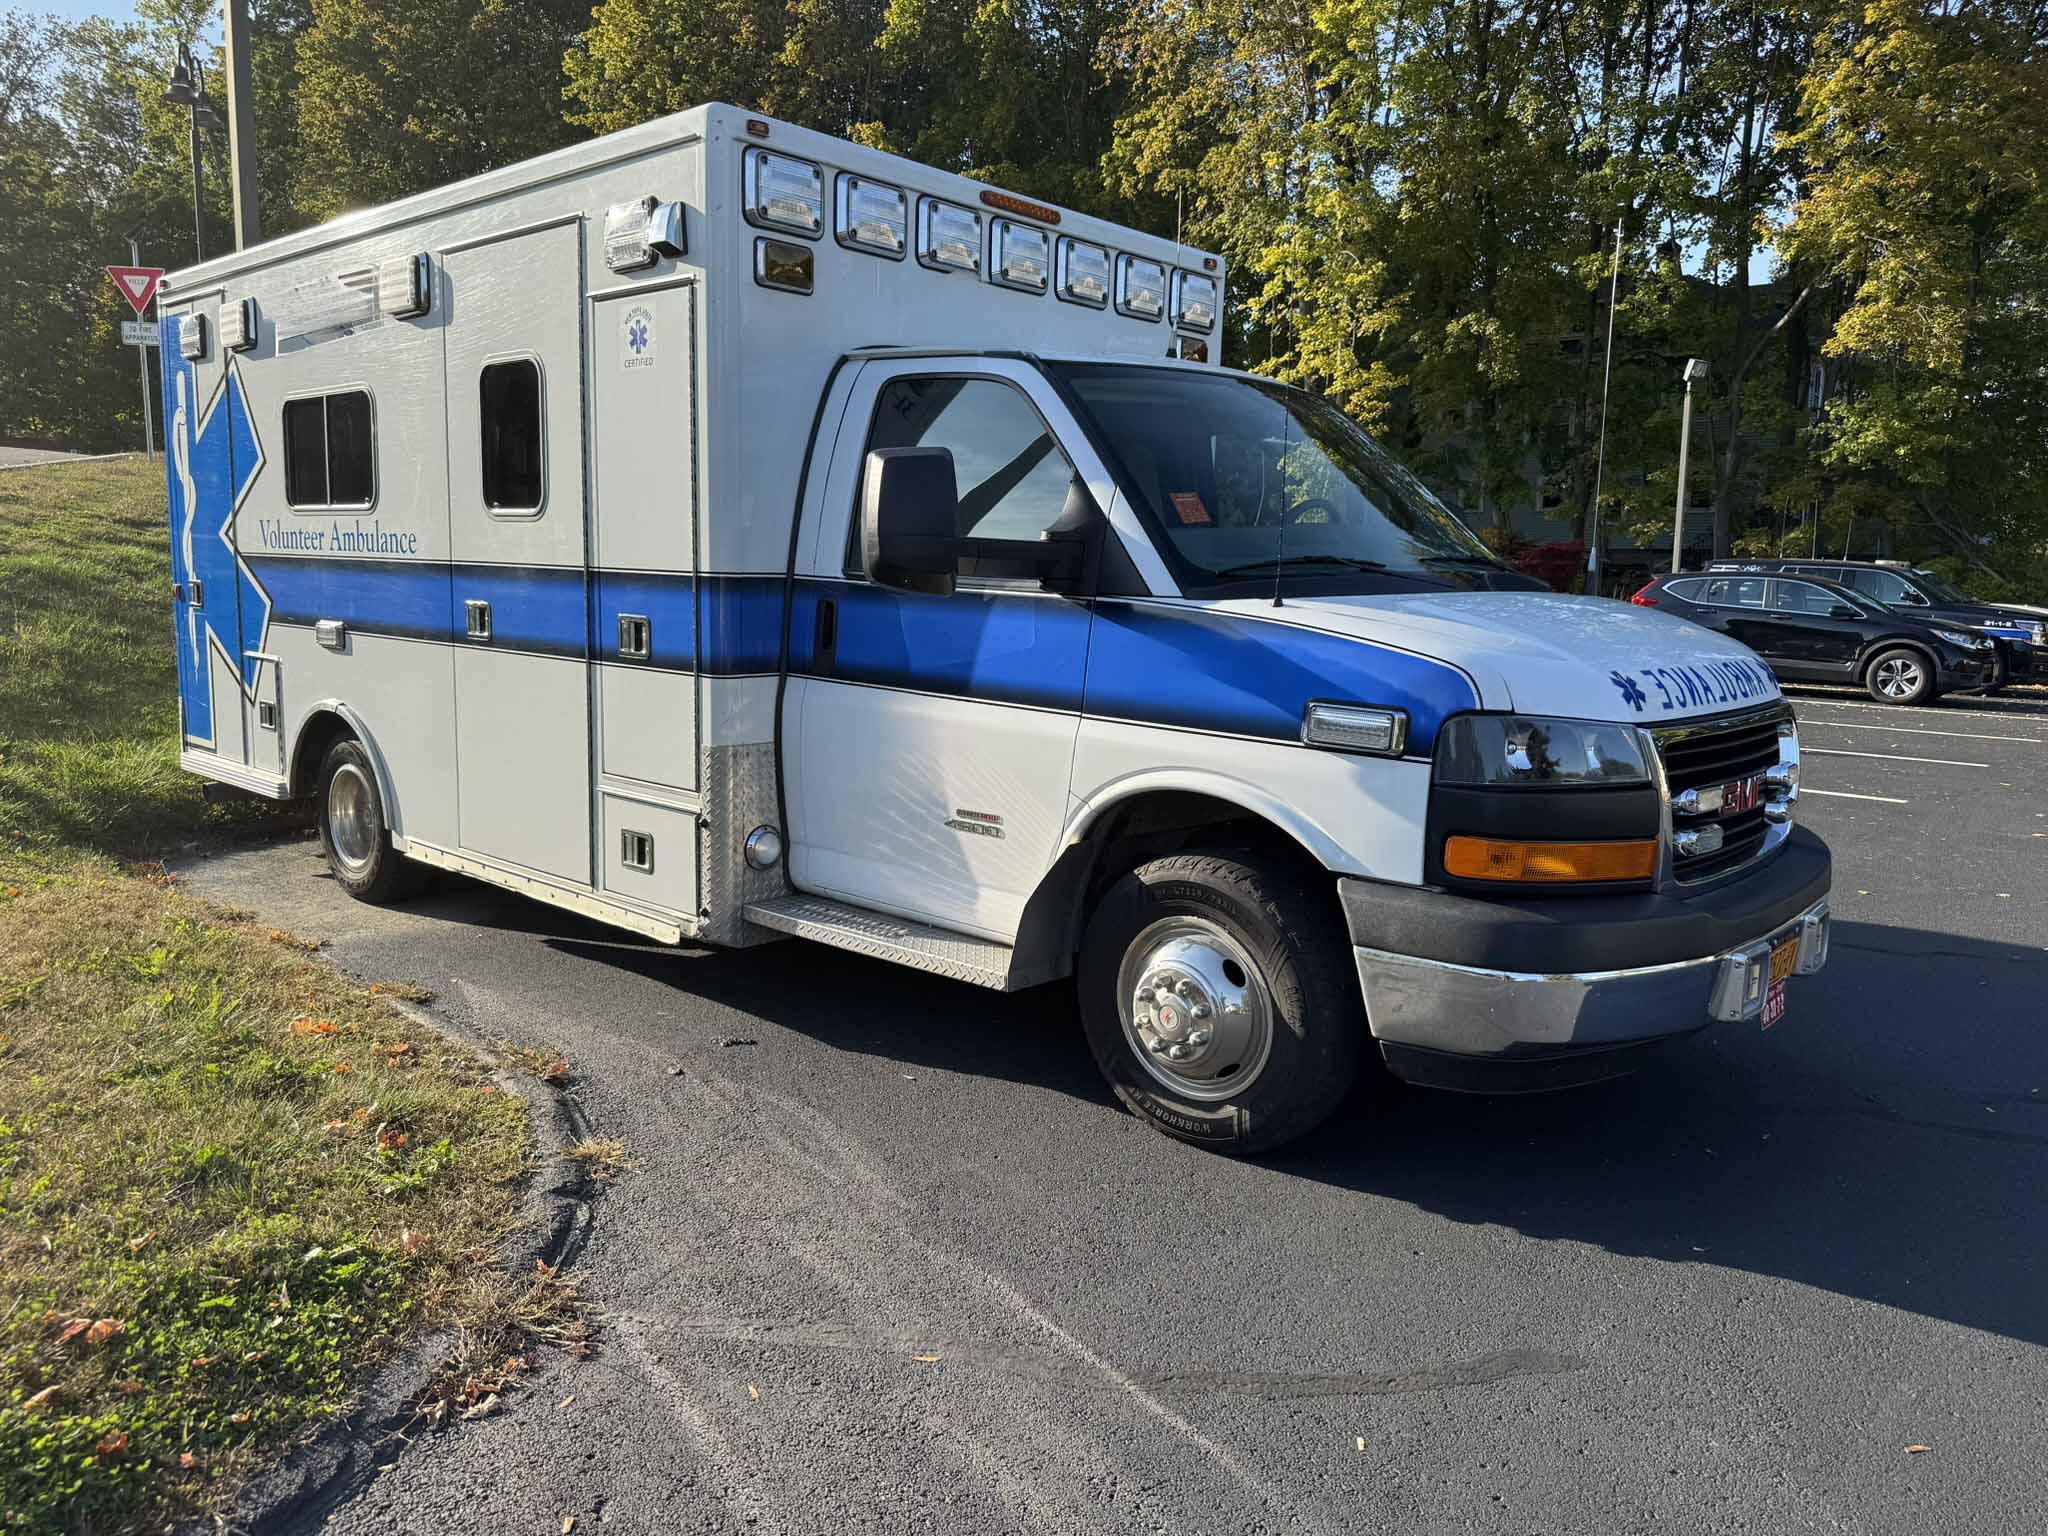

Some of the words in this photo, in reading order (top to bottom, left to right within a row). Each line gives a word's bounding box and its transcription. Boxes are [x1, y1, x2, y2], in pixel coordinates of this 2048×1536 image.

[624, 357, 654, 368] CERTIFIED
[259, 520, 325, 550] Volunteer
[330, 520, 417, 554] Ambulance
[1142, 1100, 1212, 1134] WORKHORSE
